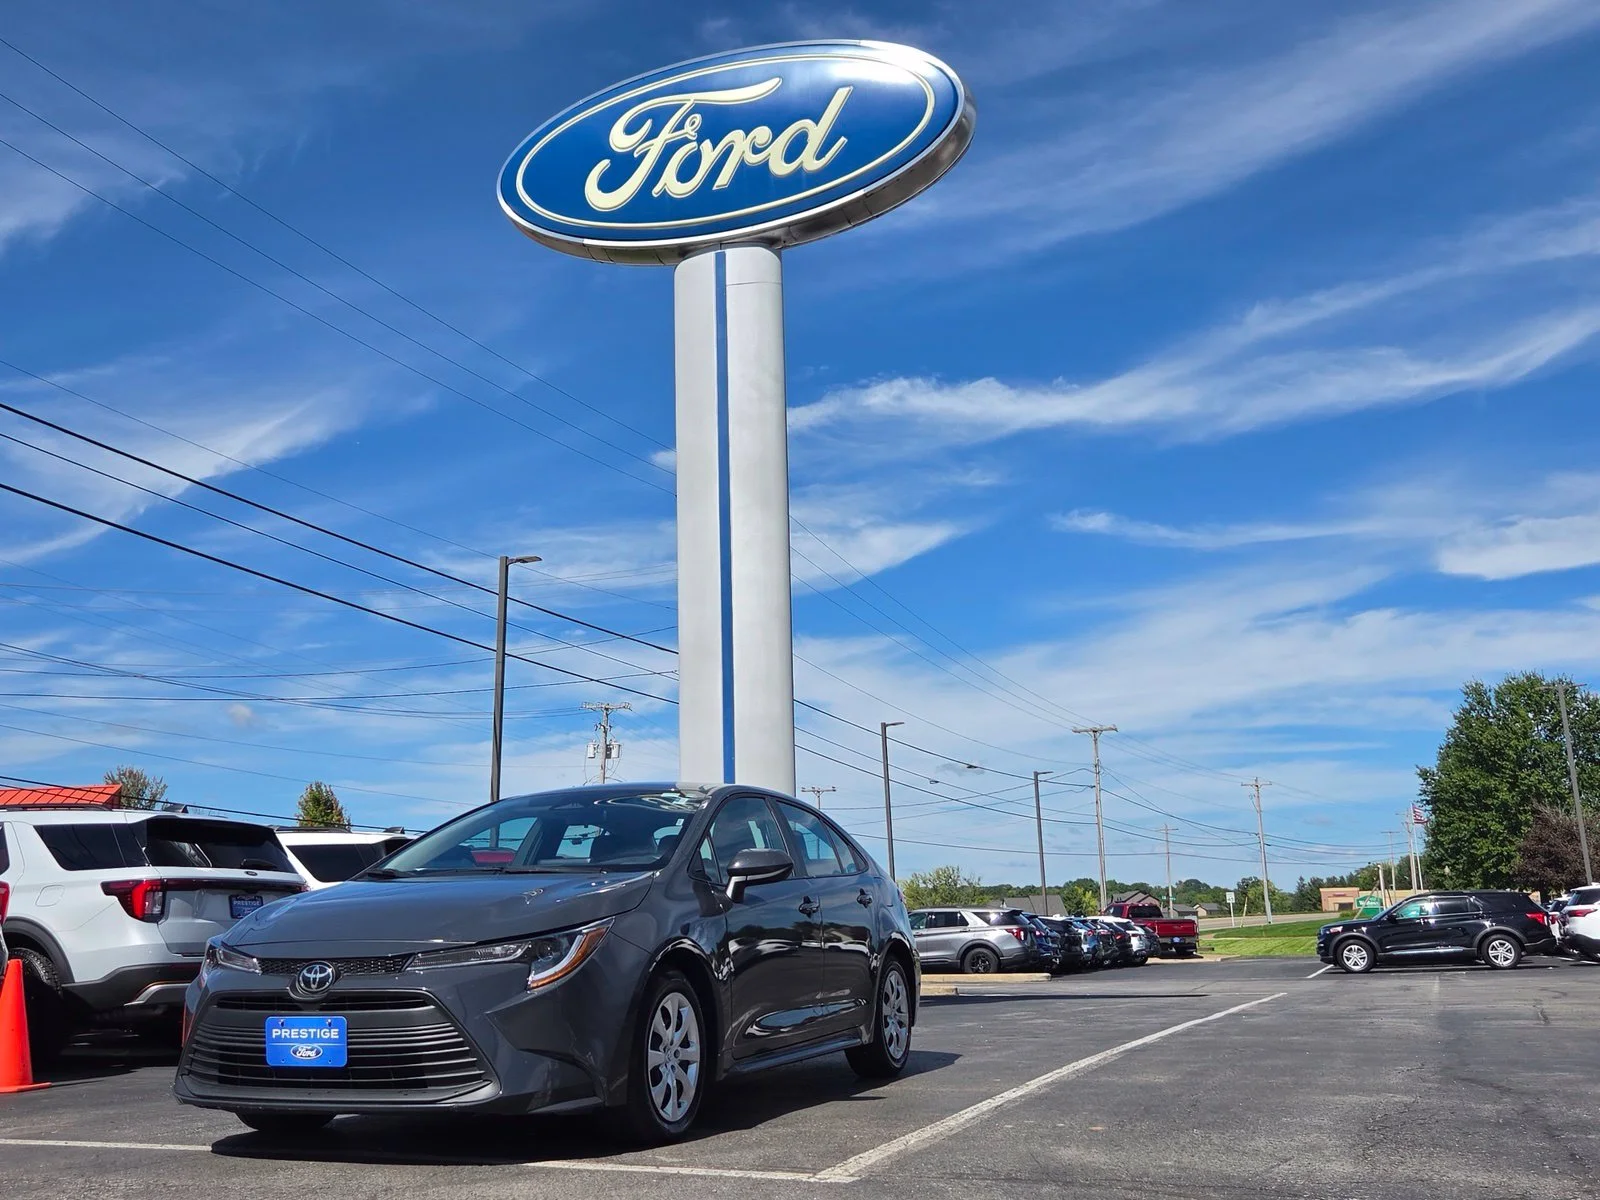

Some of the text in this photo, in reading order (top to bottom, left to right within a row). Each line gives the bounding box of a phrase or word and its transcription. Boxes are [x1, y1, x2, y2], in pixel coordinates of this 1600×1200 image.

[584, 77, 854, 211] Ford
[272, 1028, 339, 1039] PRESTIGE
[296, 1046, 317, 1057] Ford
